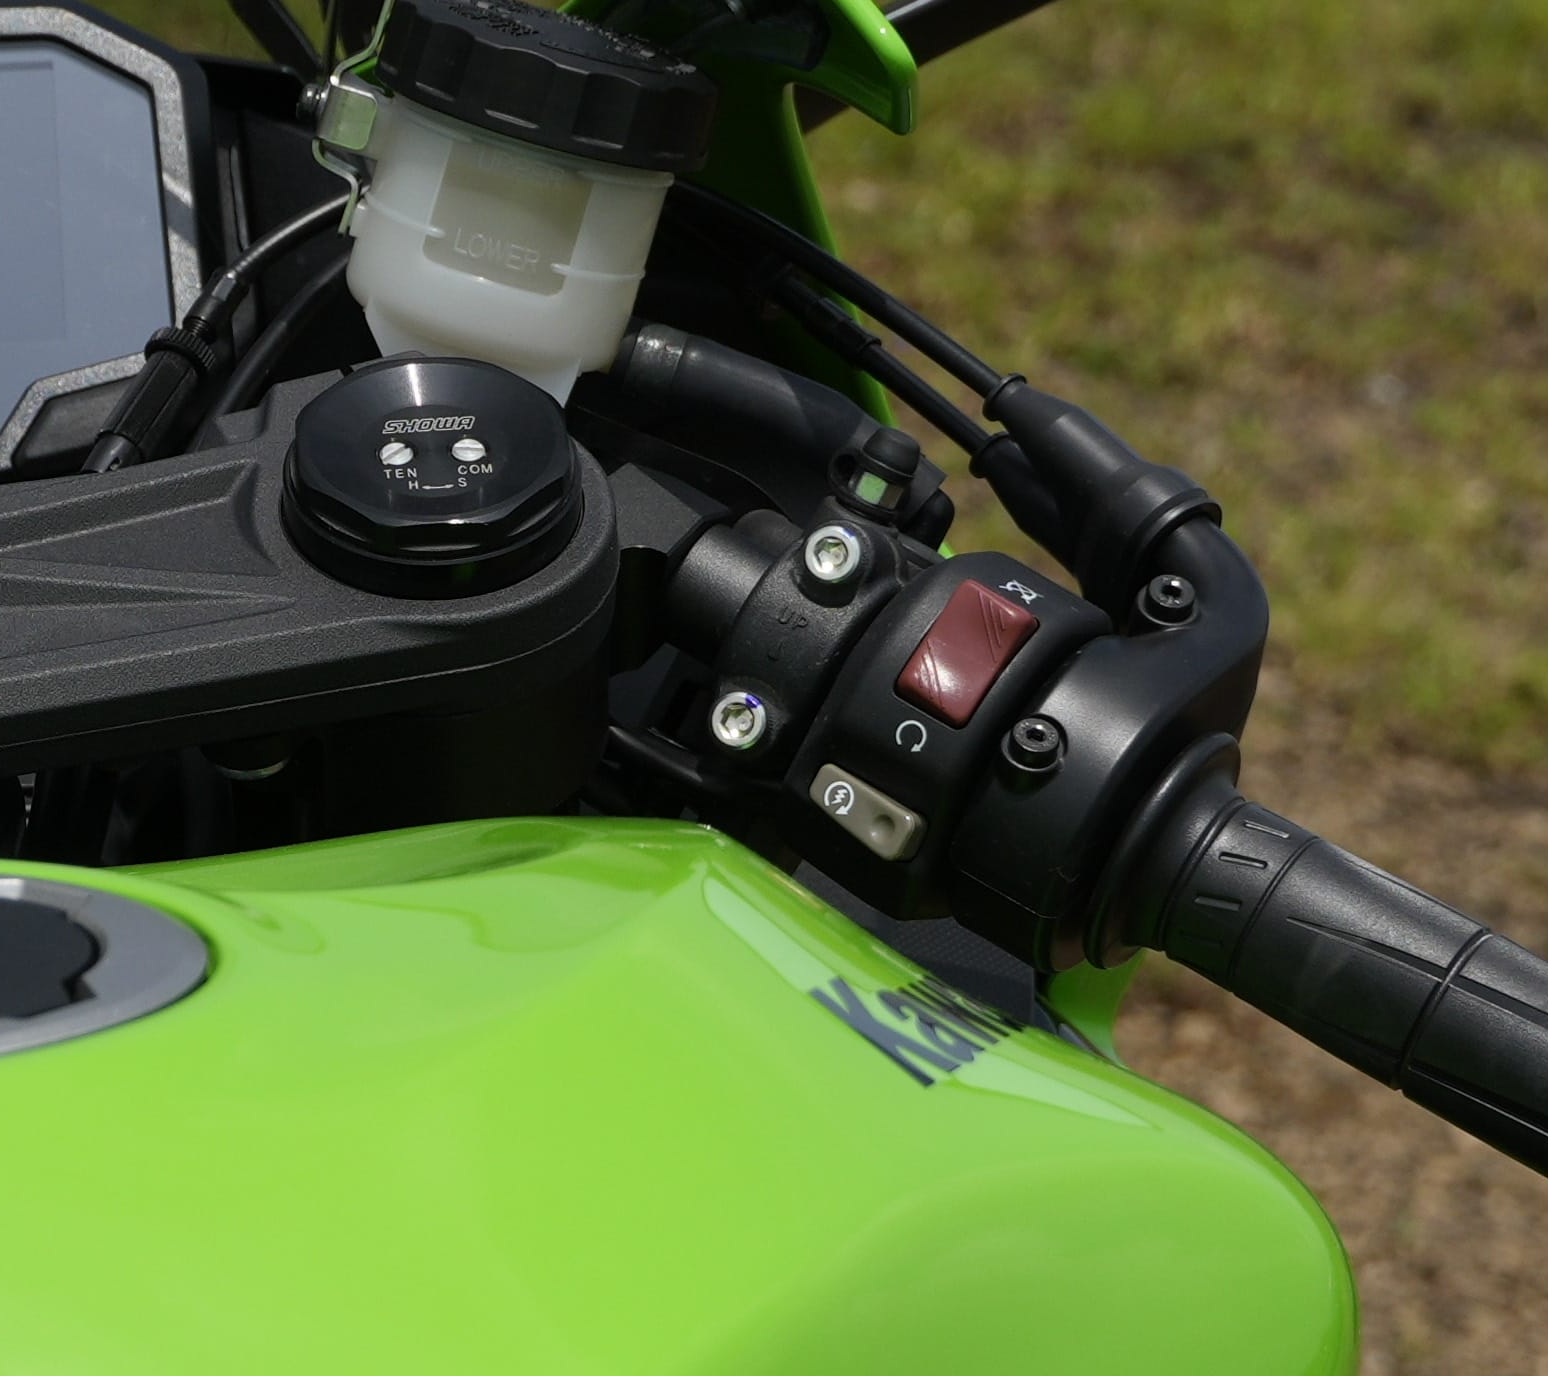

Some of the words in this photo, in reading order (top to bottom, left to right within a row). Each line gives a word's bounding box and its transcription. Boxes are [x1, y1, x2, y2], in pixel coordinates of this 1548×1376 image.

[454, 228, 540, 272] LOWER
[382, 416, 475, 434] SHOWA
[384, 468, 417, 479] TEN
[458, 464, 493, 475] COM
[409, 481, 419, 489] H
[458, 478, 467, 487] S
